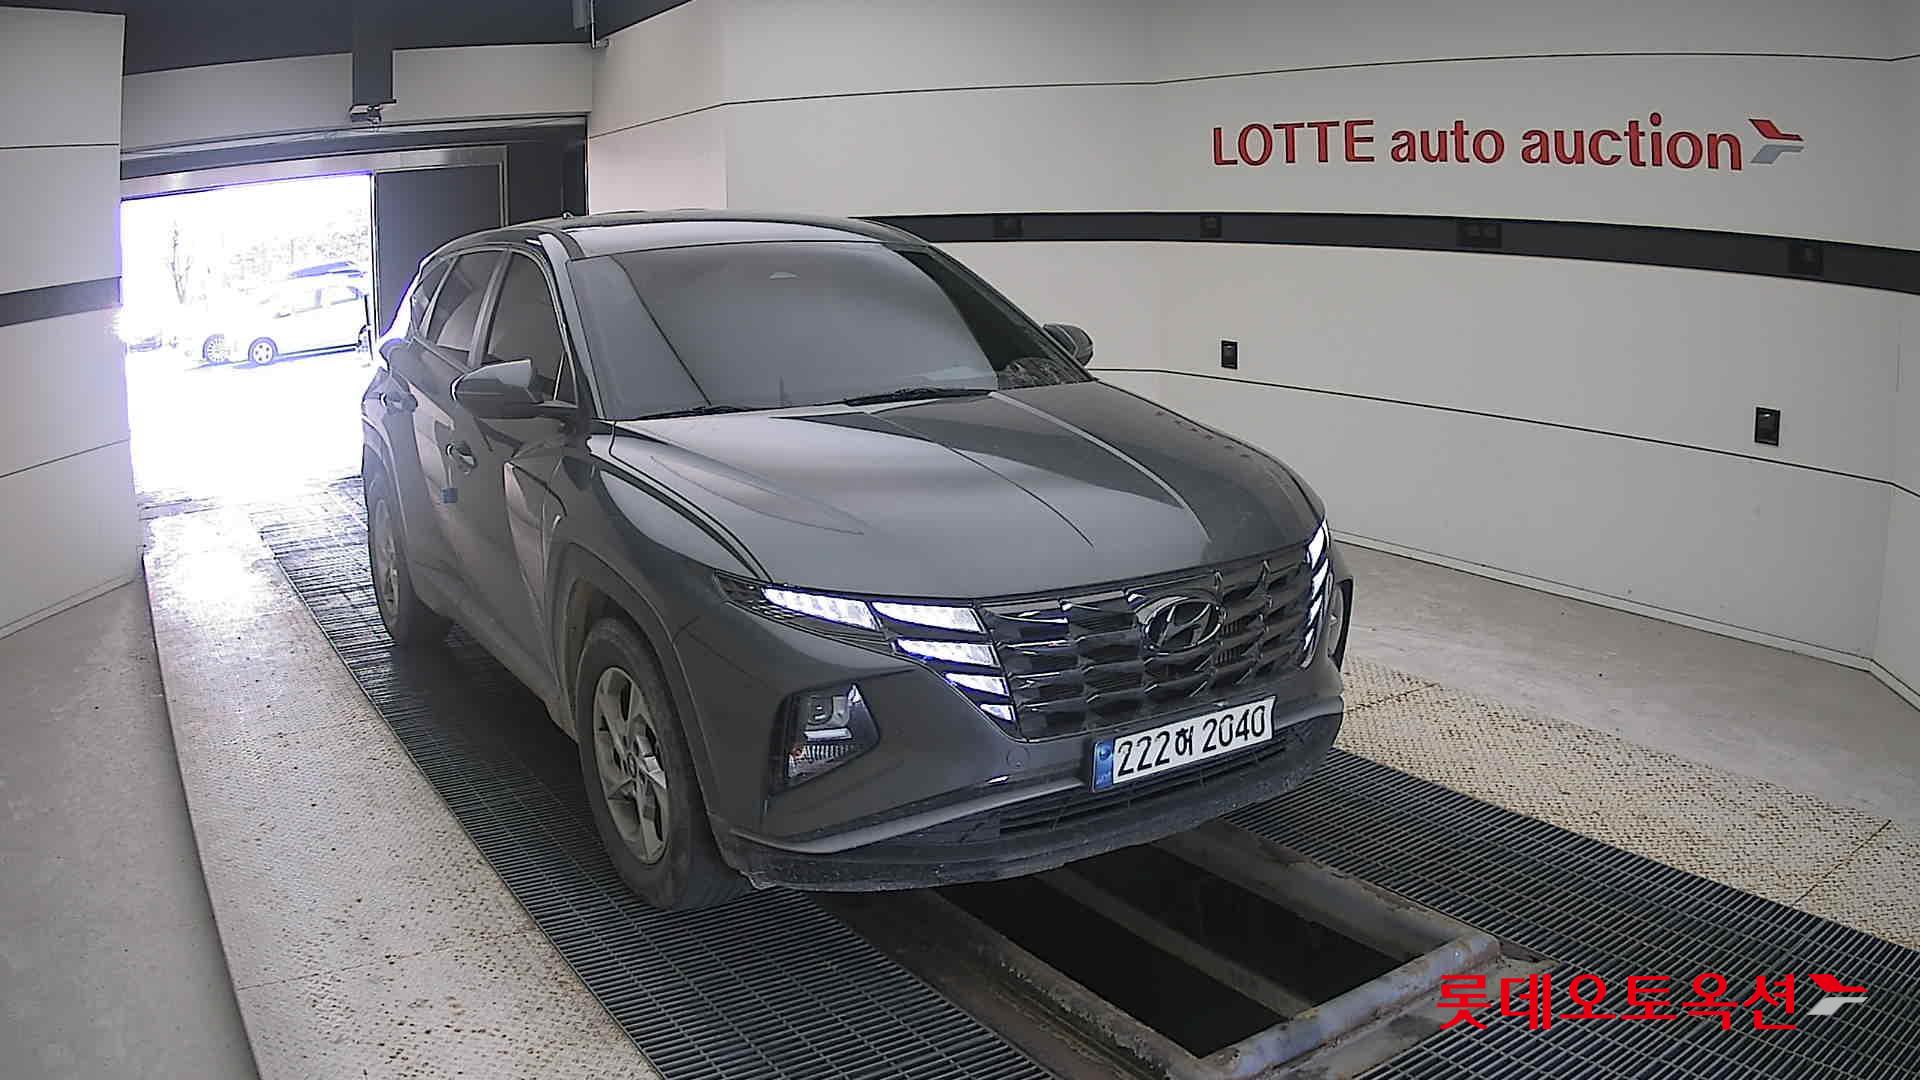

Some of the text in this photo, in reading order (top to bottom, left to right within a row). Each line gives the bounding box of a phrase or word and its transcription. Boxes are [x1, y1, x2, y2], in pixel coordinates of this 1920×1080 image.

[1212, 112, 1743, 171] LOTTE auto auction
[1117, 705, 1266, 777] 222허 2040
